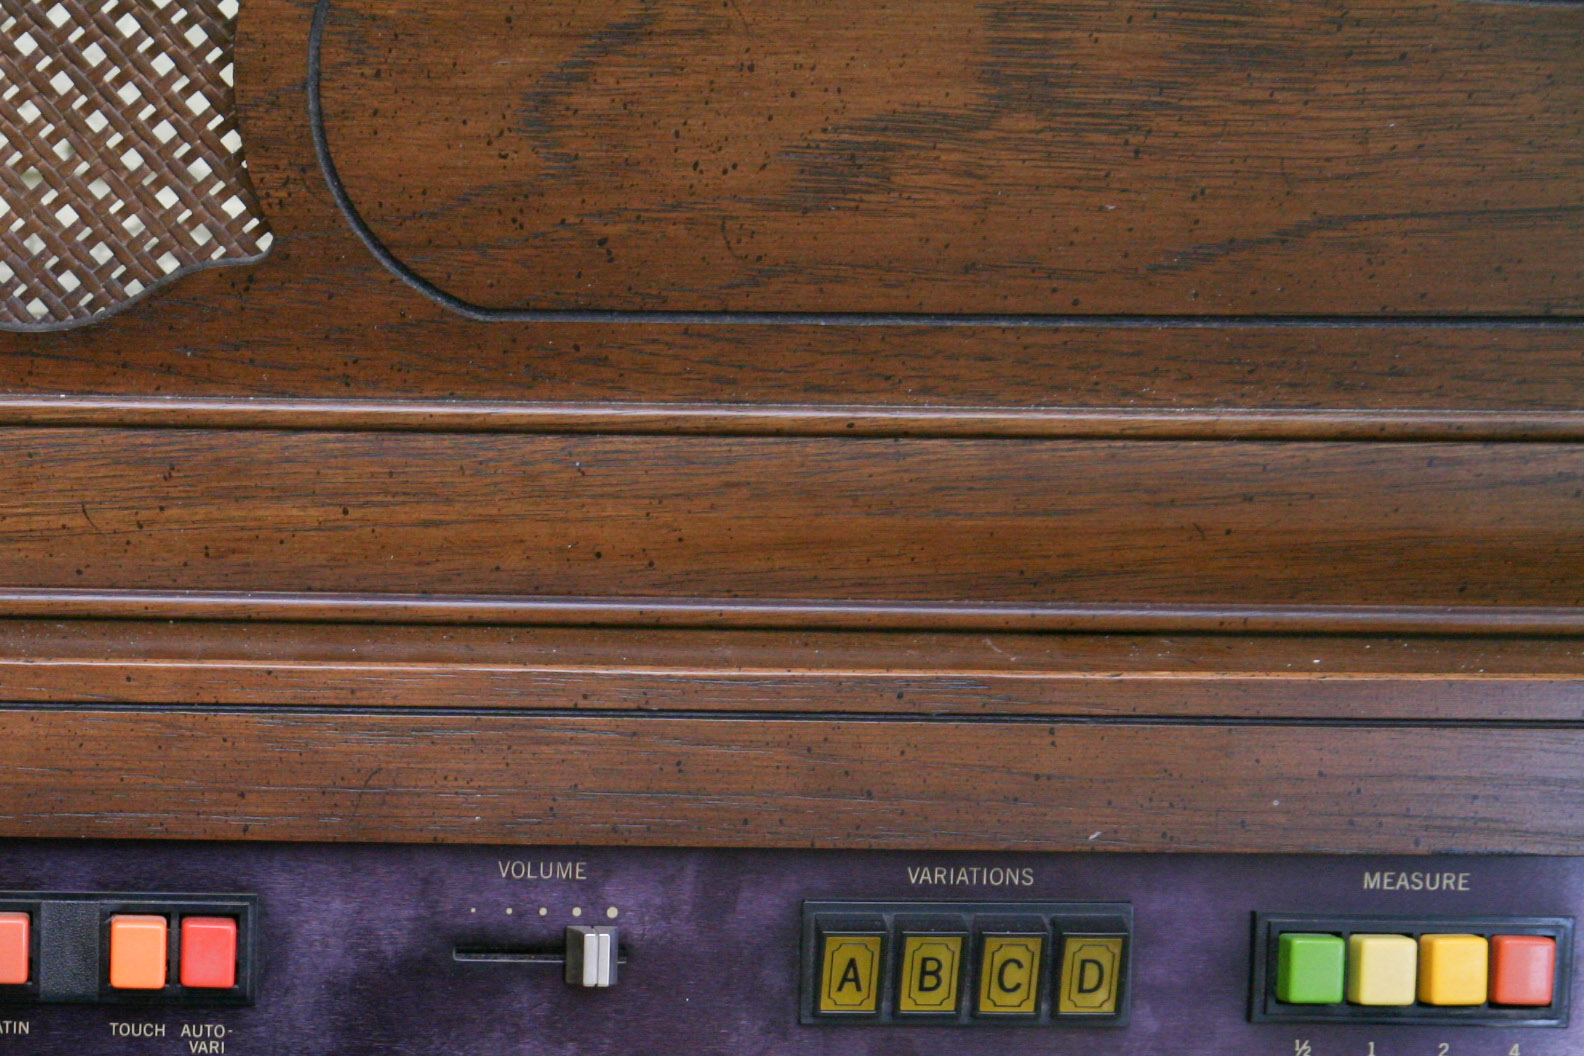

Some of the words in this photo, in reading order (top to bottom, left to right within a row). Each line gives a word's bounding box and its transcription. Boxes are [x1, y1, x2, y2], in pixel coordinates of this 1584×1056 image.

[498, 861, 587, 880] VOLUME
[908, 867, 1034, 886] VARIATIONS
[1363, 871, 1471, 891] MEASURE
[837, 957, 862, 993] A
[918, 956, 944, 992] B
[998, 958, 1024, 994] C
[1077, 959, 1105, 994] D
[109, 1022, 166, 1038] TOUCH
[181, 1024, 233, 1039] AUTO-
[188, 1040, 225, 1055] VARI
